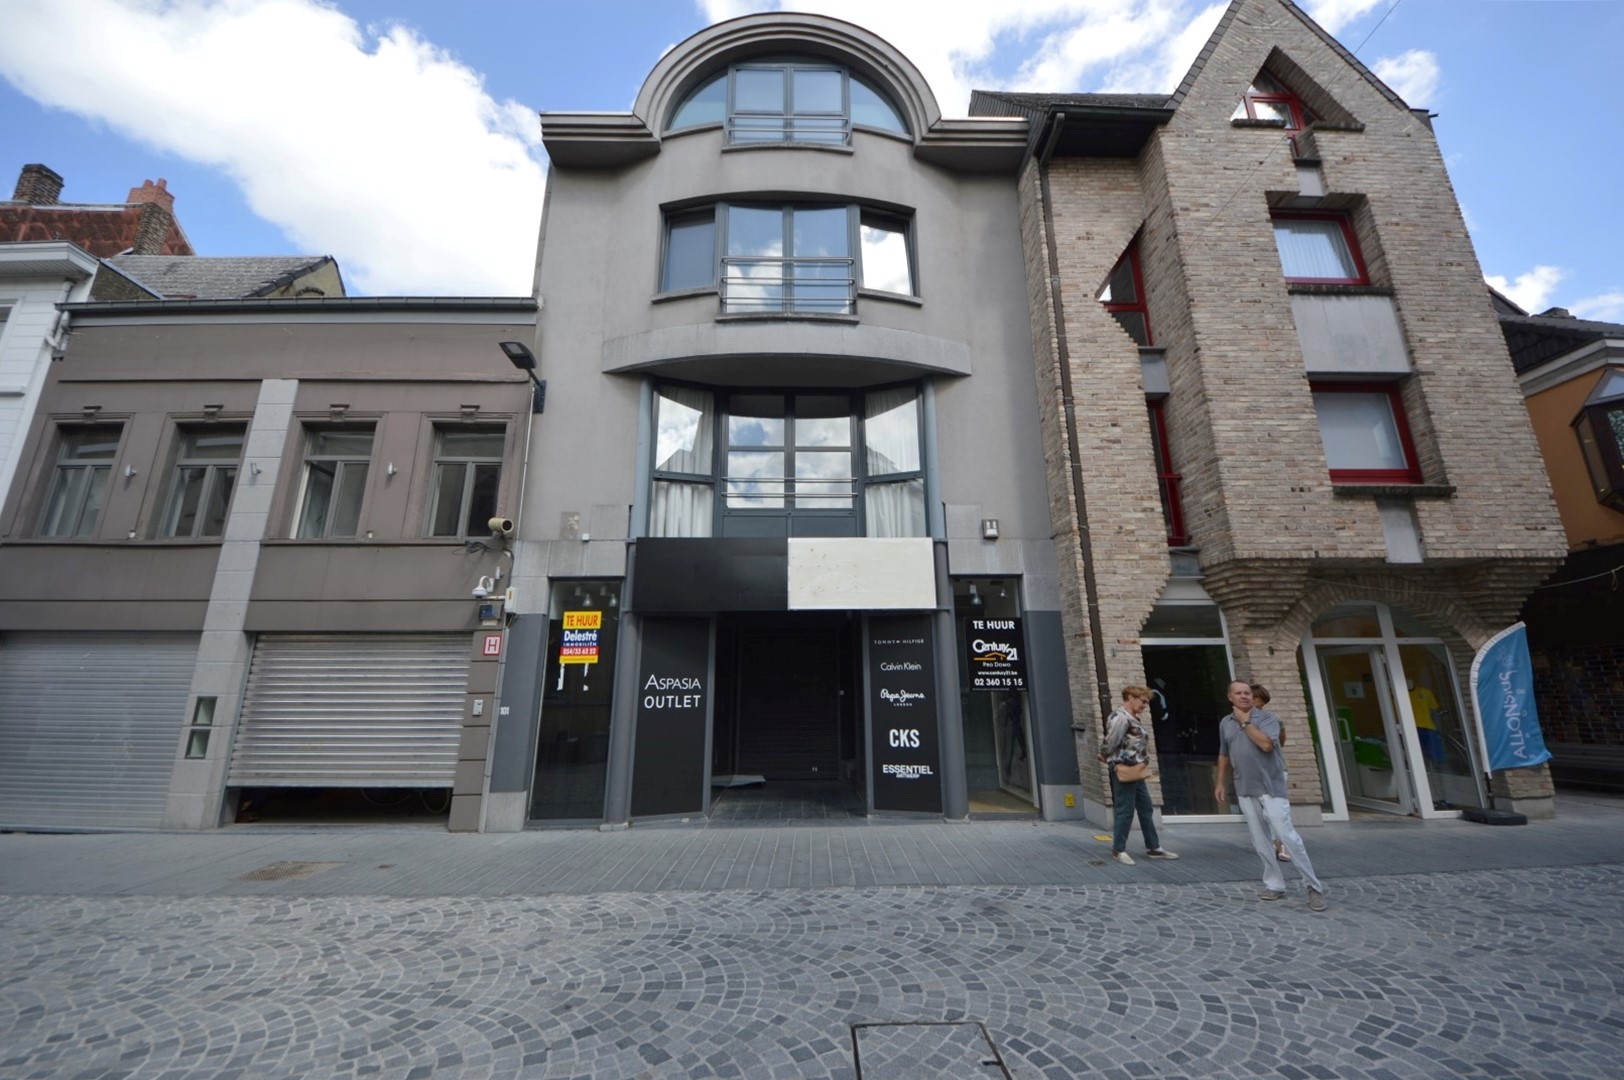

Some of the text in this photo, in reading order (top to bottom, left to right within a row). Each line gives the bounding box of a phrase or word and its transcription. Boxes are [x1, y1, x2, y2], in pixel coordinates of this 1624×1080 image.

[566, 615, 598, 626] TE HUUR
[973, 620, 1015, 630] TE HUUR
[564, 629, 597, 642] Delestré
[972, 639, 1018, 661] Century 21
[880, 662, 922, 671] Calvin Klein
[644, 674, 702, 690] ASPASIA
[974, 678, 1023, 686] 02 360 15 15
[880, 688, 925, 702] Pepe Jeans
[644, 695, 702, 709] OUTLET
[889, 728, 920, 748] CKS
[882, 764, 934, 775] ESSENTIEL
